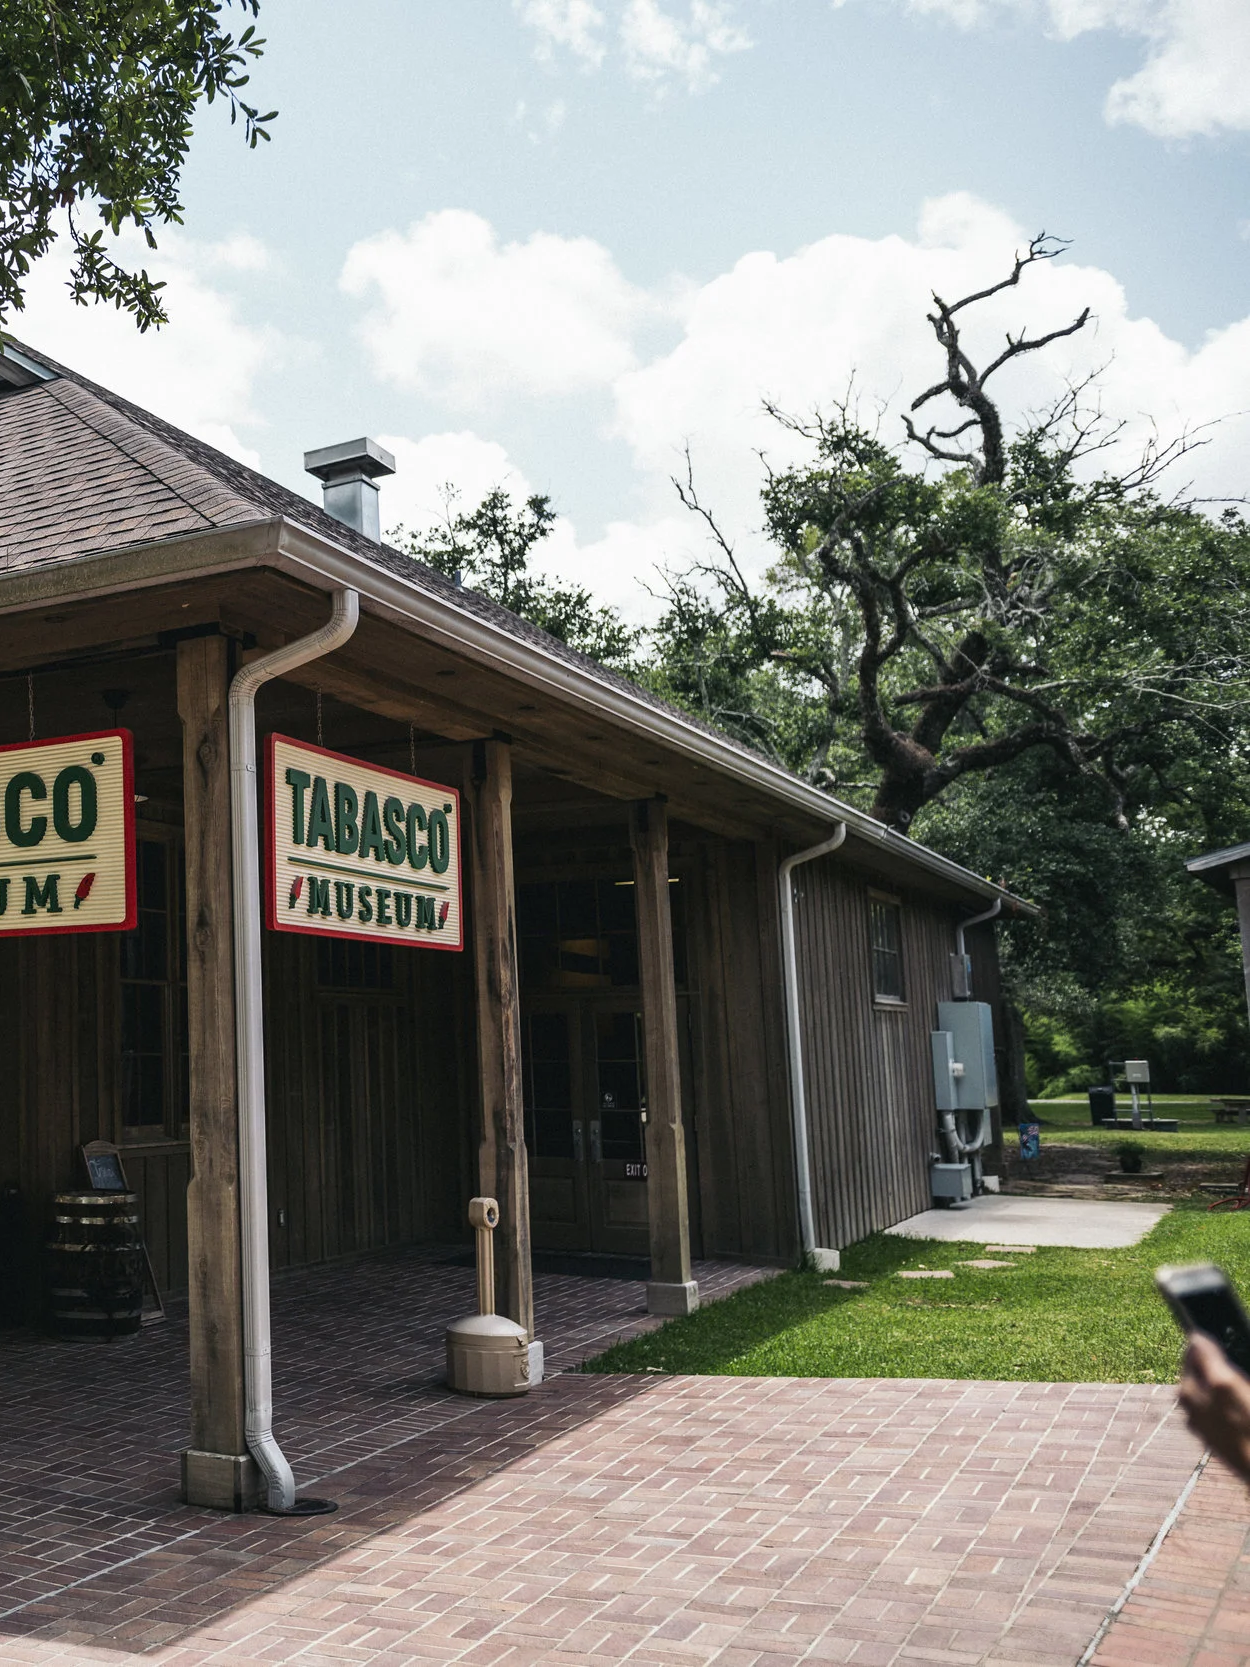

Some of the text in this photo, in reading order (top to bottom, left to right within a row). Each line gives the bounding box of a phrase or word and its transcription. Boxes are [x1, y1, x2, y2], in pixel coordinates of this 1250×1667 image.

[286, 767, 450, 874] TABASCO
[306, 876, 438, 930] MUSEUM
[626, 1163, 641, 1177] EXIT
